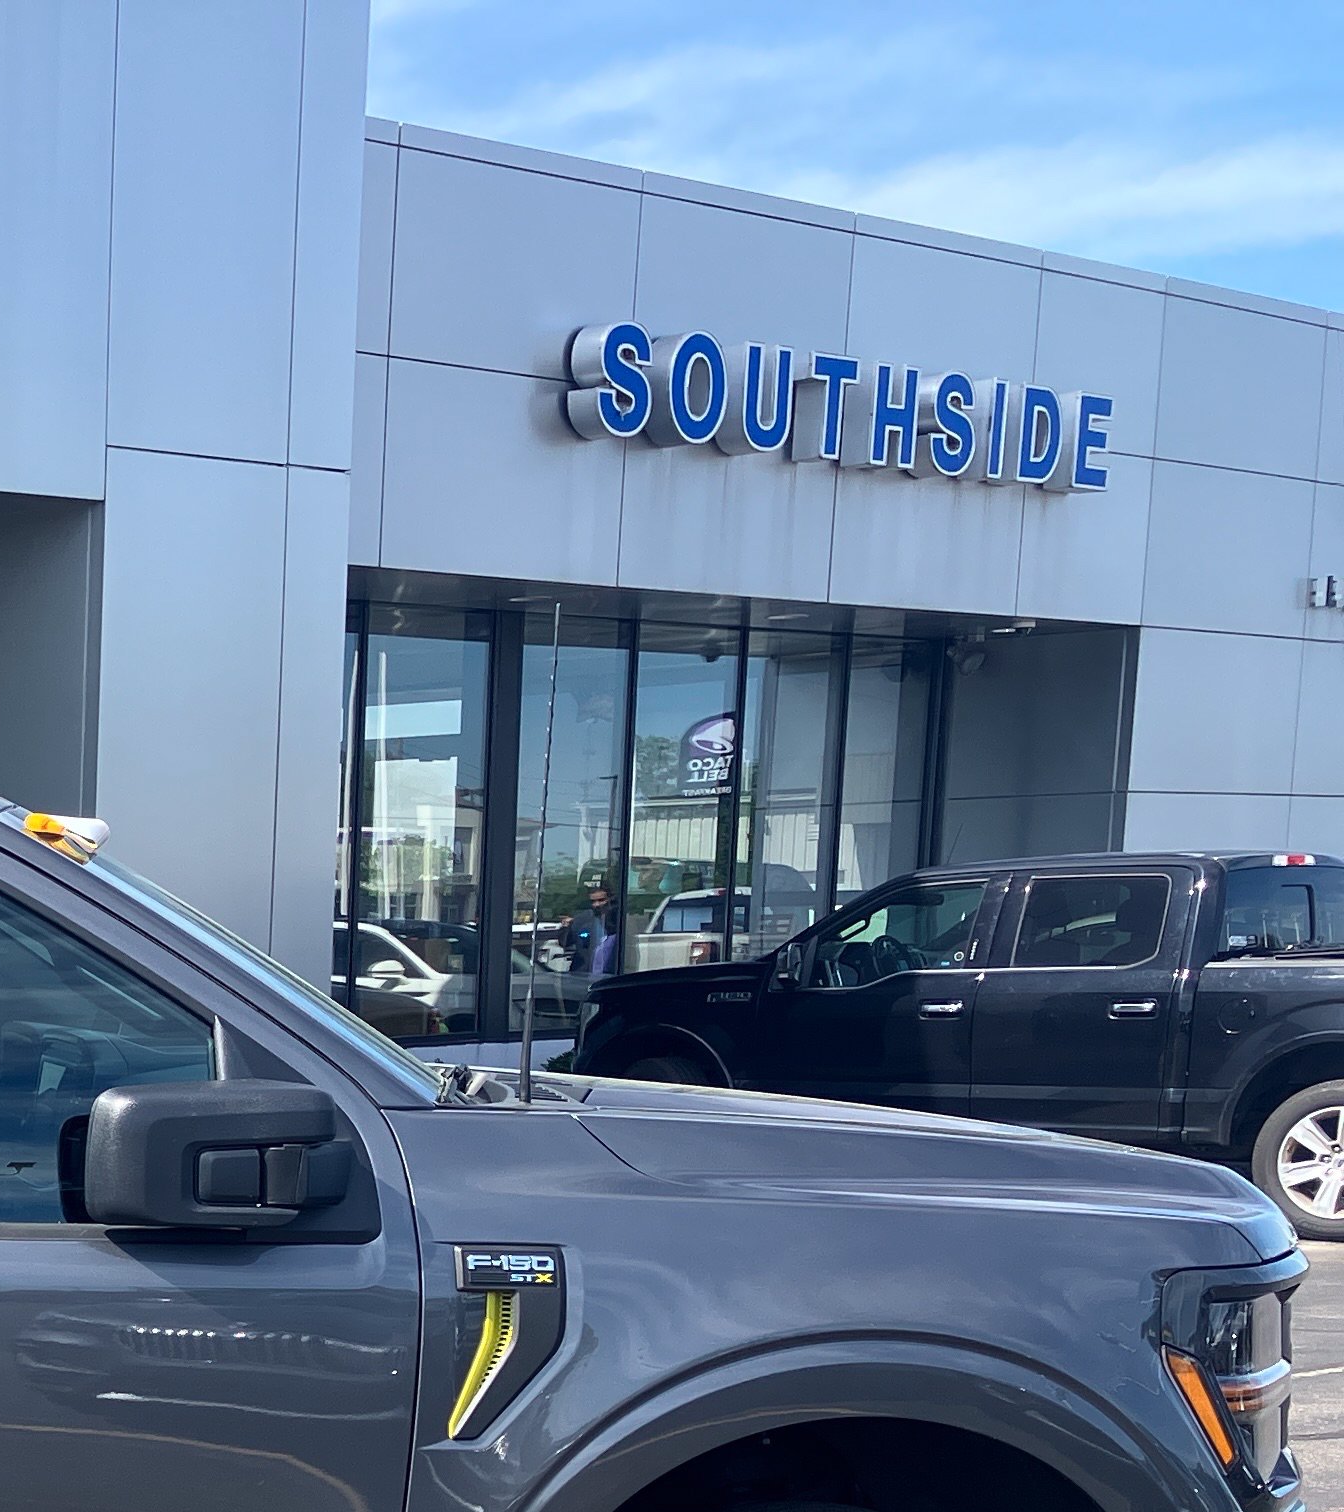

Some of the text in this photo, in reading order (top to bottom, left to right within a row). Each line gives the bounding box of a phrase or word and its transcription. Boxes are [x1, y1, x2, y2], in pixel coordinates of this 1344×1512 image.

[568, 320, 1114, 492] SOUTHSIDE
[466, 1254, 556, 1272] F-150
[509, 1273, 554, 1283] STX
